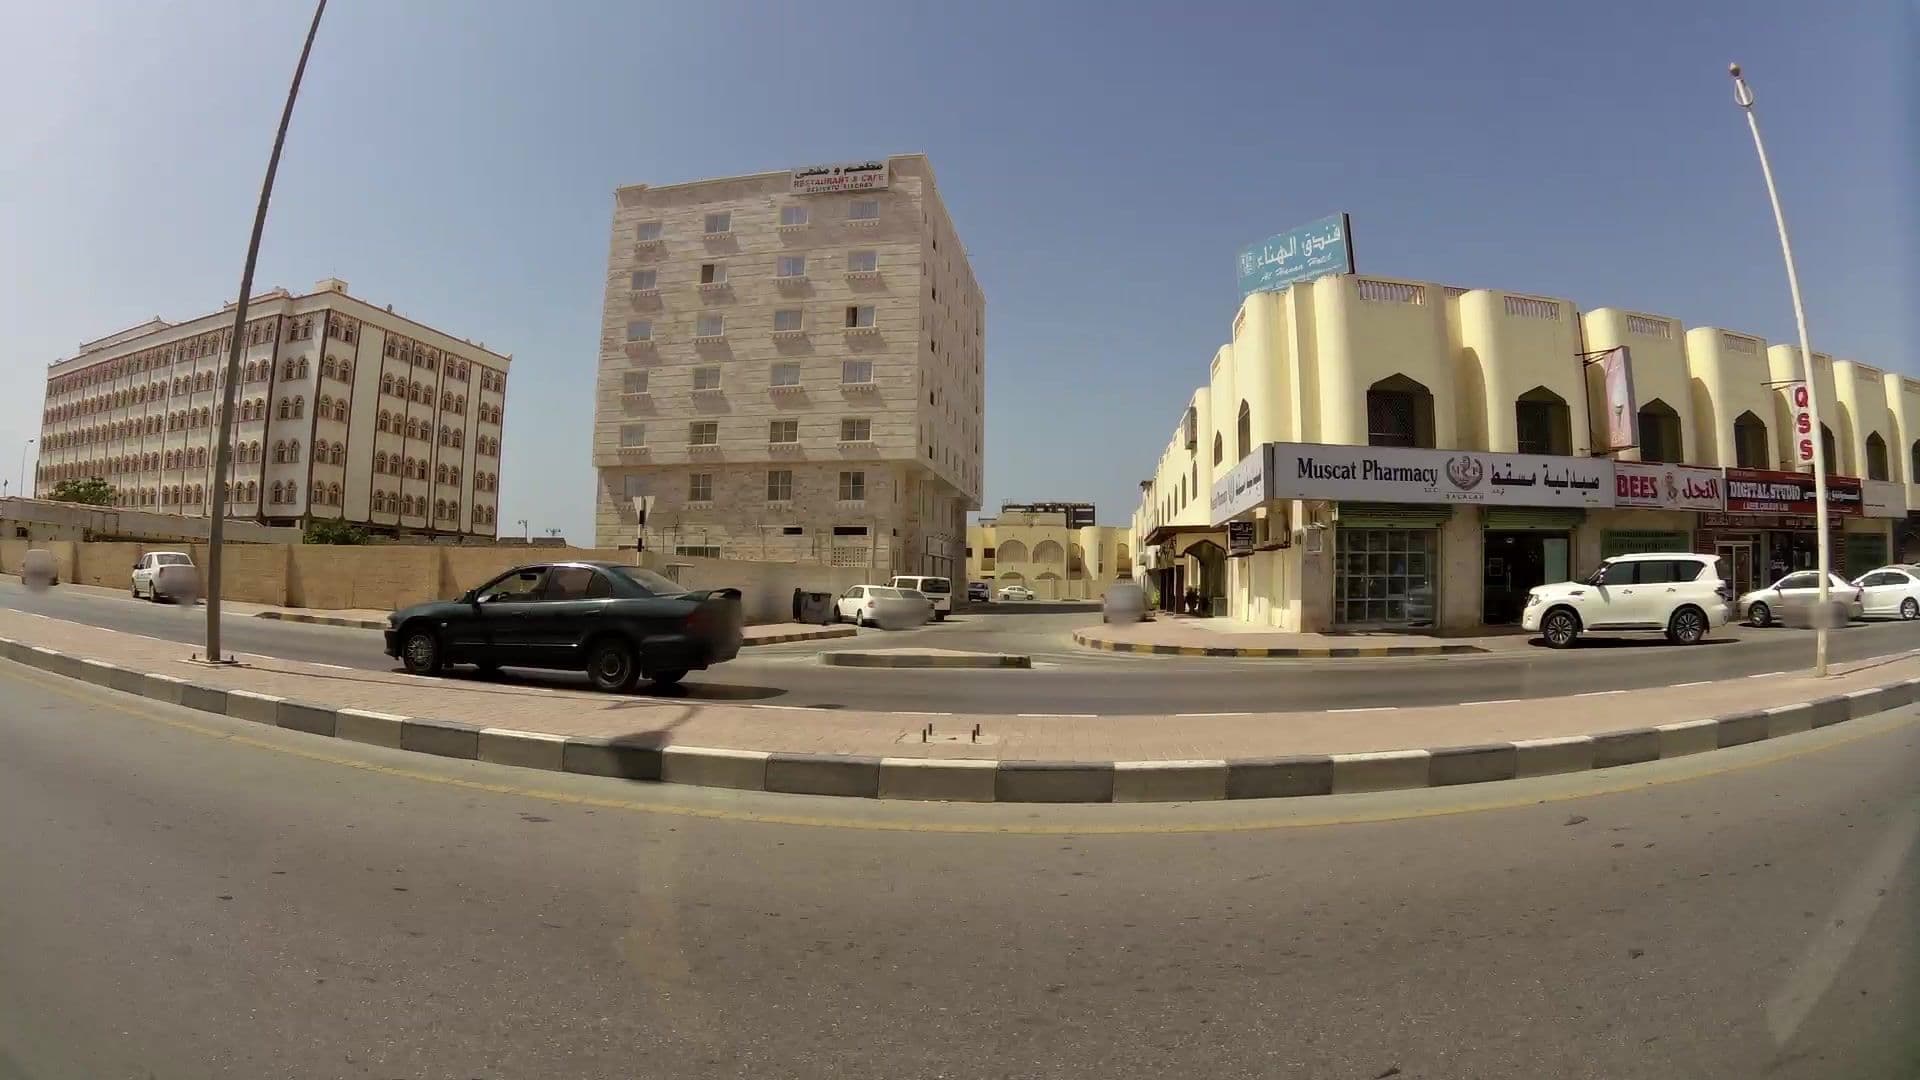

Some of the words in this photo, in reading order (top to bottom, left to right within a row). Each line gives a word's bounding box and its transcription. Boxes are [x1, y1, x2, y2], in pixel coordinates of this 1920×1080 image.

[793, 176, 849, 188] RESTAURANT
[1257, 235, 1297, 267] الهناء
[1301, 223, 1341, 257] فندق
[1297, 457, 1357, 480] Muscat
[1362, 459, 1438, 487] Pharmacy
[1490, 463, 1536, 487] مسقط
[1543, 464, 1600, 496] صيدلية
[1616, 474, 1658, 499] BEES
[1682, 477, 1720, 499] النحل
[1729, 481, 1770, 499] DIGITAL
[1770, 484, 1801, 501] STUDIO
